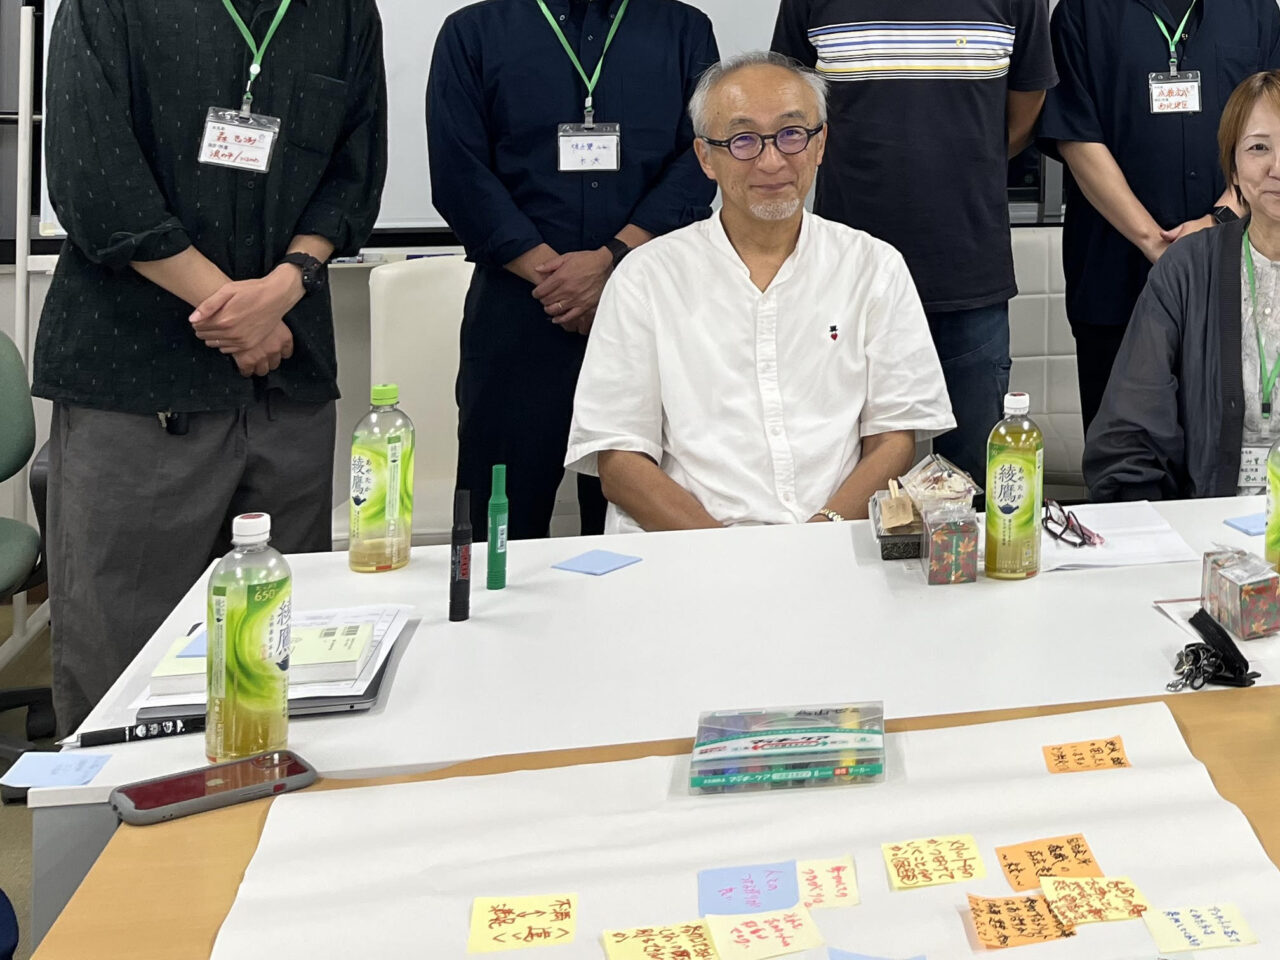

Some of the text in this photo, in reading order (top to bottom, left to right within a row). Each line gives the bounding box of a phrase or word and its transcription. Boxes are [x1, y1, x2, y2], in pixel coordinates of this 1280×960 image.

[352, 456, 365, 495] 綾鷹
[998, 463, 1017, 503] 綾鷹
[1017, 466, 1025, 500] あやたか
[254, 589, 276, 602] 650
